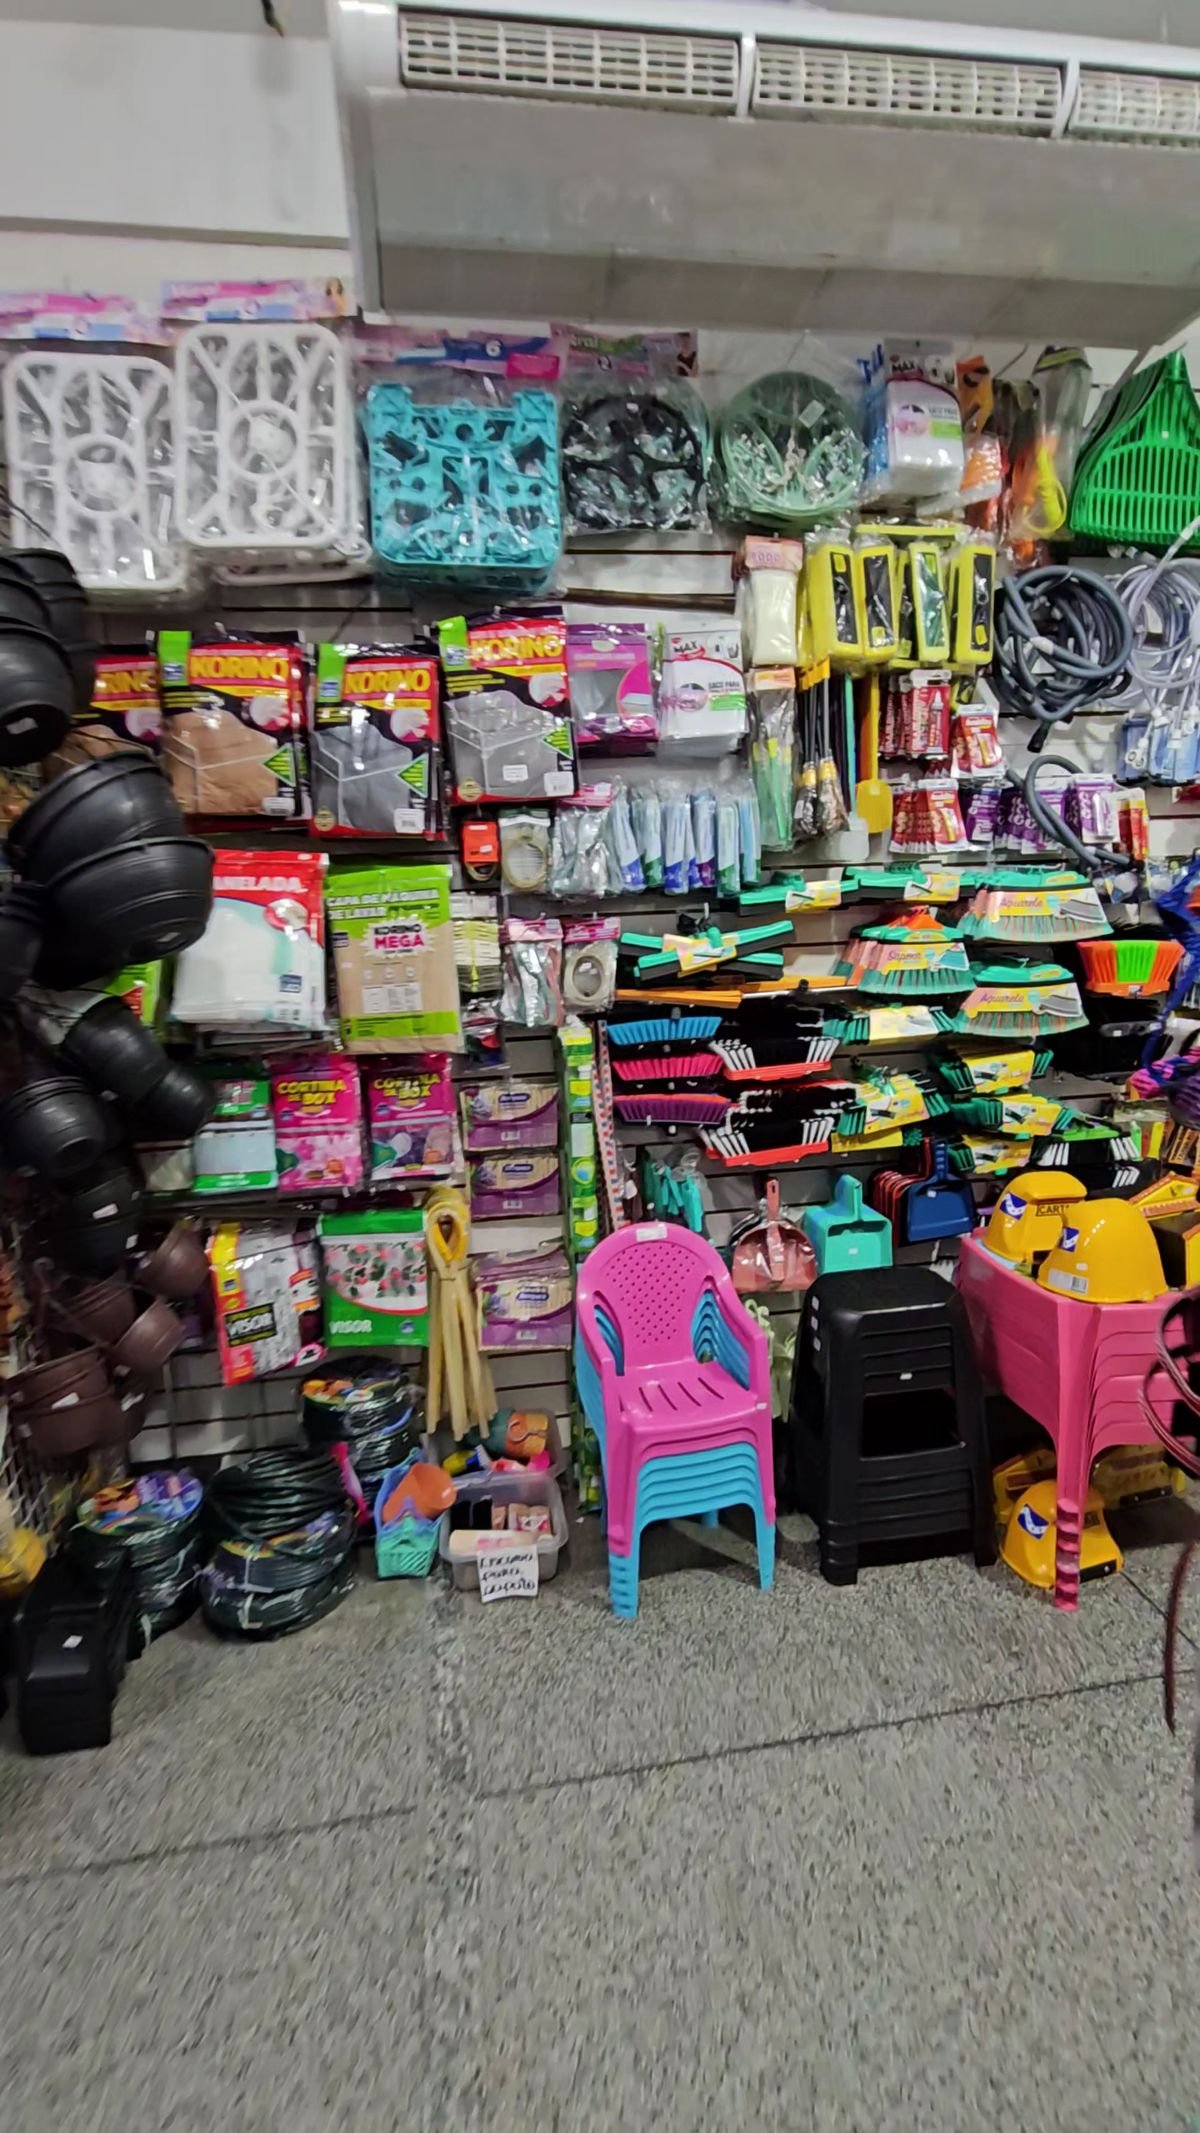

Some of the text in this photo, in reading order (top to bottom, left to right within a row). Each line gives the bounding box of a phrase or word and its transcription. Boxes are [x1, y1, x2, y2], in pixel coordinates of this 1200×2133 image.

[471, 634, 563, 661] KORINO
[674, 640, 698, 653] MAX
[190, 656, 289, 681] KORINO
[96, 671, 157, 694] RINO
[343, 669, 431, 694] KORINO
[212, 875, 302, 892] ANELADA
[374, 934, 425, 949] MEGA
[277, 1079, 347, 1095] CORTINA
[301, 1091, 337, 1105] BOX
[1037, 1204, 1070, 1215] CART
[228, 1312, 274, 1338] VISOR
[329, 1319, 373, 1335] VISOR
